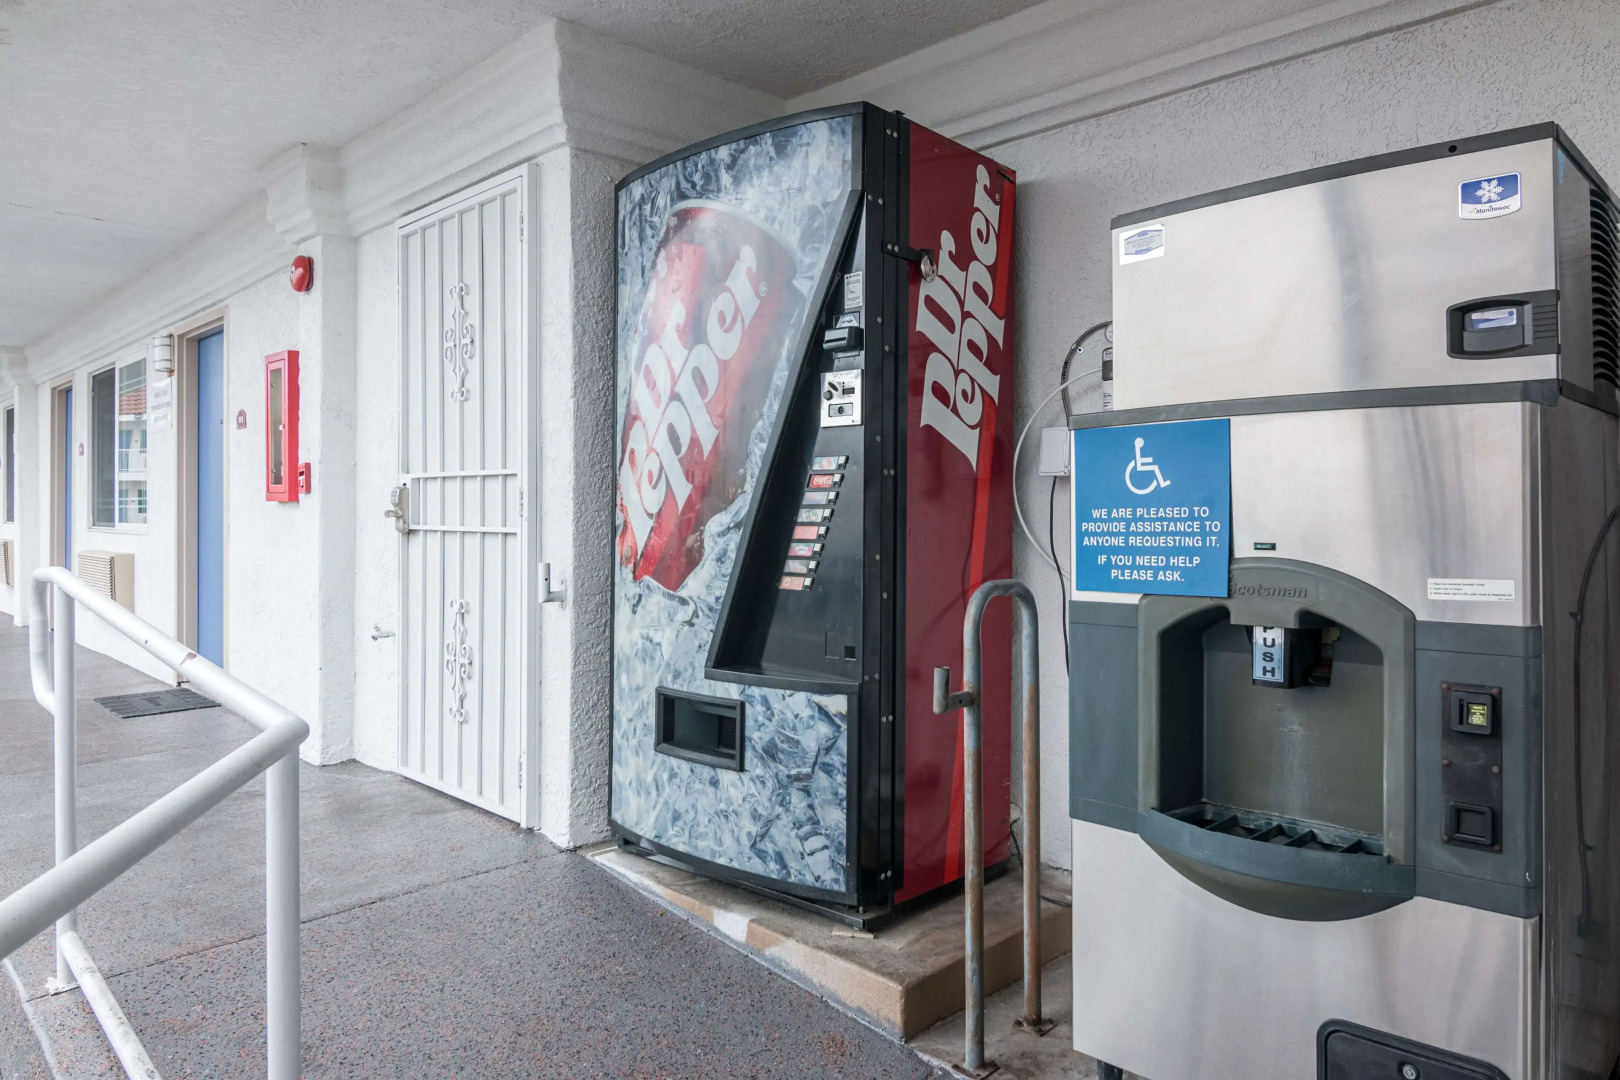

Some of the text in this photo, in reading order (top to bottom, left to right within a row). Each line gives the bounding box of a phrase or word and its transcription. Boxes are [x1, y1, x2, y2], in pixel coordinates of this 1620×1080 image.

[1475, 204, 1511, 215] Manitowoc
[916, 164, 1006, 473] Dr Pepper
[620, 245, 763, 561] Dr Pepper
[1091, 506, 1209, 519] WE ARE PLEASED TO
[1081, 521, 1221, 532] PROVIDE ASSISTANCE TO
[1083, 536, 1220, 547] ANYONE REQUESTING IT.
[1097, 555, 1201, 567] IF YOU NEED HELP
[1111, 569, 1185, 582] PLEASE ASK.
[1229, 582, 1308, 599] Scotsman
